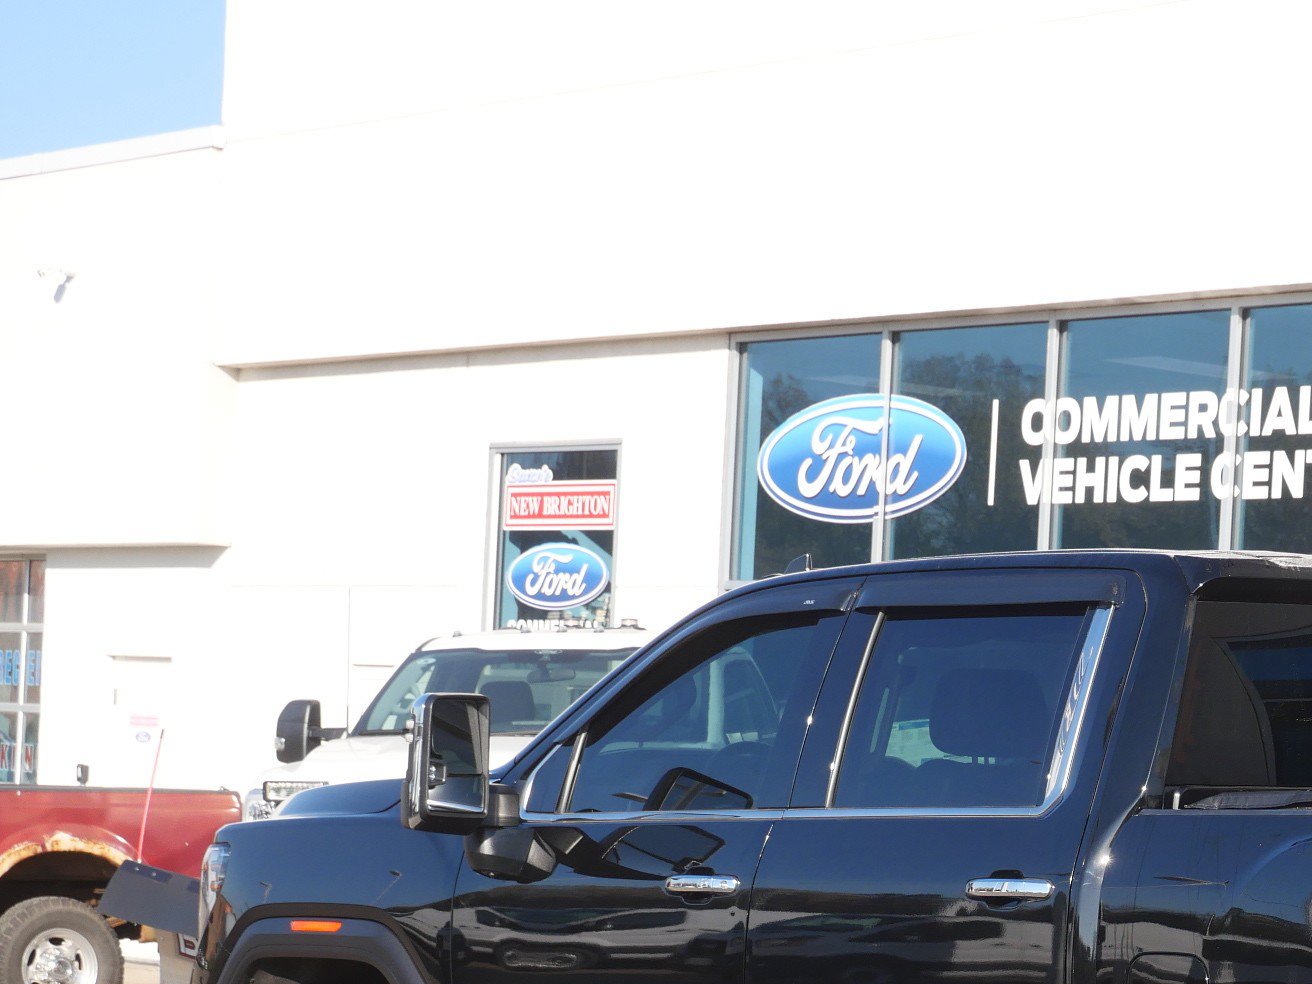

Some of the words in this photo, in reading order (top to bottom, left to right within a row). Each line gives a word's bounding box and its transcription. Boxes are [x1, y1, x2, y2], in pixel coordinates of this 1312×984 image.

[797, 416, 923, 498] Ford
[1018, 452, 1202, 506] VEHICLE
[510, 497, 541, 516] NEW
[543, 494, 610, 516] BRIGHTON
[525, 551, 589, 597] Ford
